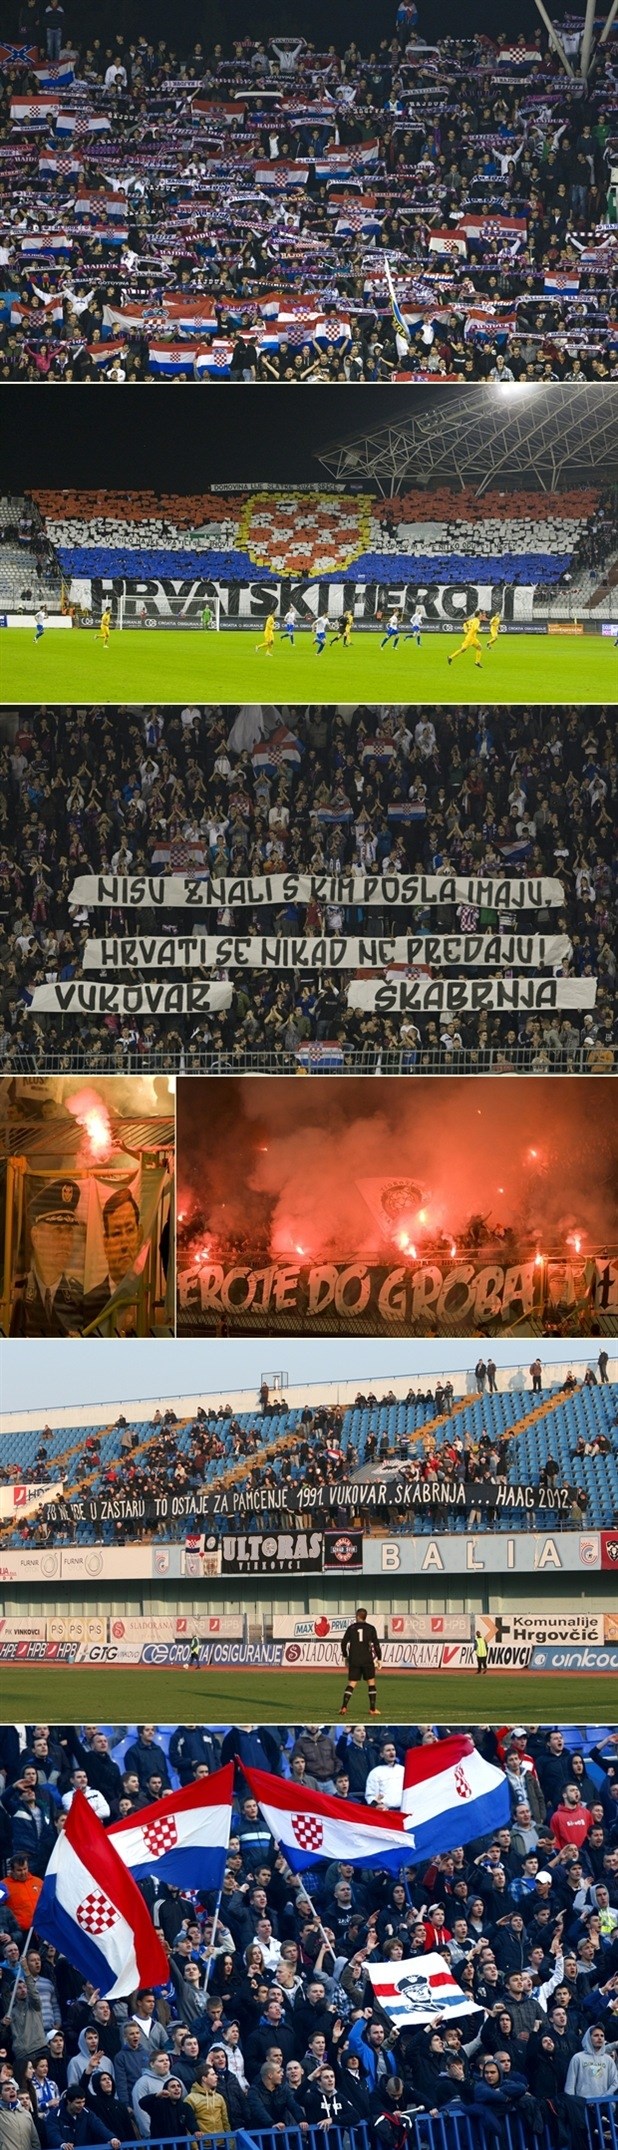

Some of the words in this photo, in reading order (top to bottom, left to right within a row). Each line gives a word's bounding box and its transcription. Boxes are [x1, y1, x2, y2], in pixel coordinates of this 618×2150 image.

[185, 231, 217, 242] HAJDUK
[160, 249, 192, 257] HAJDUK
[214, 483, 248, 491] DOMOVINA
[91, 579, 330, 618] HRVATSKI
[343, 582, 514, 621] HEROJI
[98, 877, 165, 903] NISU
[184, 877, 272, 905] ZNALI
[282, 874, 300, 900] S
[310, 876, 355, 902] KIM
[363, 876, 457, 903] POSLA
[467, 878, 552, 908] IMAJU,
[101, 938, 206, 966] HRVATI
[216, 937, 251, 966] SE
[261, 936, 348, 967] NIKAD
[358, 939, 396, 966] NE
[407, 936, 546, 967] PREDAJU!
[55, 984, 211, 1012] VUKOVAR
[374, 979, 557, 1012] ŠKABRNJA
[305, 1263, 370, 1317] DO
[378, 1264, 537, 1325] GROBA
[46, 1504, 57, 1521] TO
[59, 1503, 71, 1520] NE
[90, 1502, 97, 1520] U
[101, 1499, 146, 1520] ZASTARU
[154, 1498, 168, 1516] TO
[172, 1495, 209, 1516] OSTAJE
[213, 1494, 229, 1513] ZA
[233, 1488, 288, 1511] PAMĆENJE
[296, 1487, 324, 1508] 1991.
[495, 1485, 535, 1508] HAAG
[538, 1488, 573, 1509] 2012.
[130, 1621, 172, 1630] SLADORANA
[221, 1620, 240, 1630] HPB
[331, 1619, 347, 1630] PRVA
[444, 1620, 466, 1630] HPB
[513, 1616, 599, 1629] Komunalije
[14, 1628, 40, 1636] VINKOVCI
[296, 1629, 313, 1639] MAX
[357, 1628, 364, 1642] 1
[513, 1628, 599, 1644] Hrgovčić
[28, 1643, 46, 1658] HPB
[57, 1642, 78, 1658] HPB
[89, 1646, 118, 1660] GTG
[459, 1647, 474, 1665] PIK
[582, 2061, 607, 2069] DINAMO
